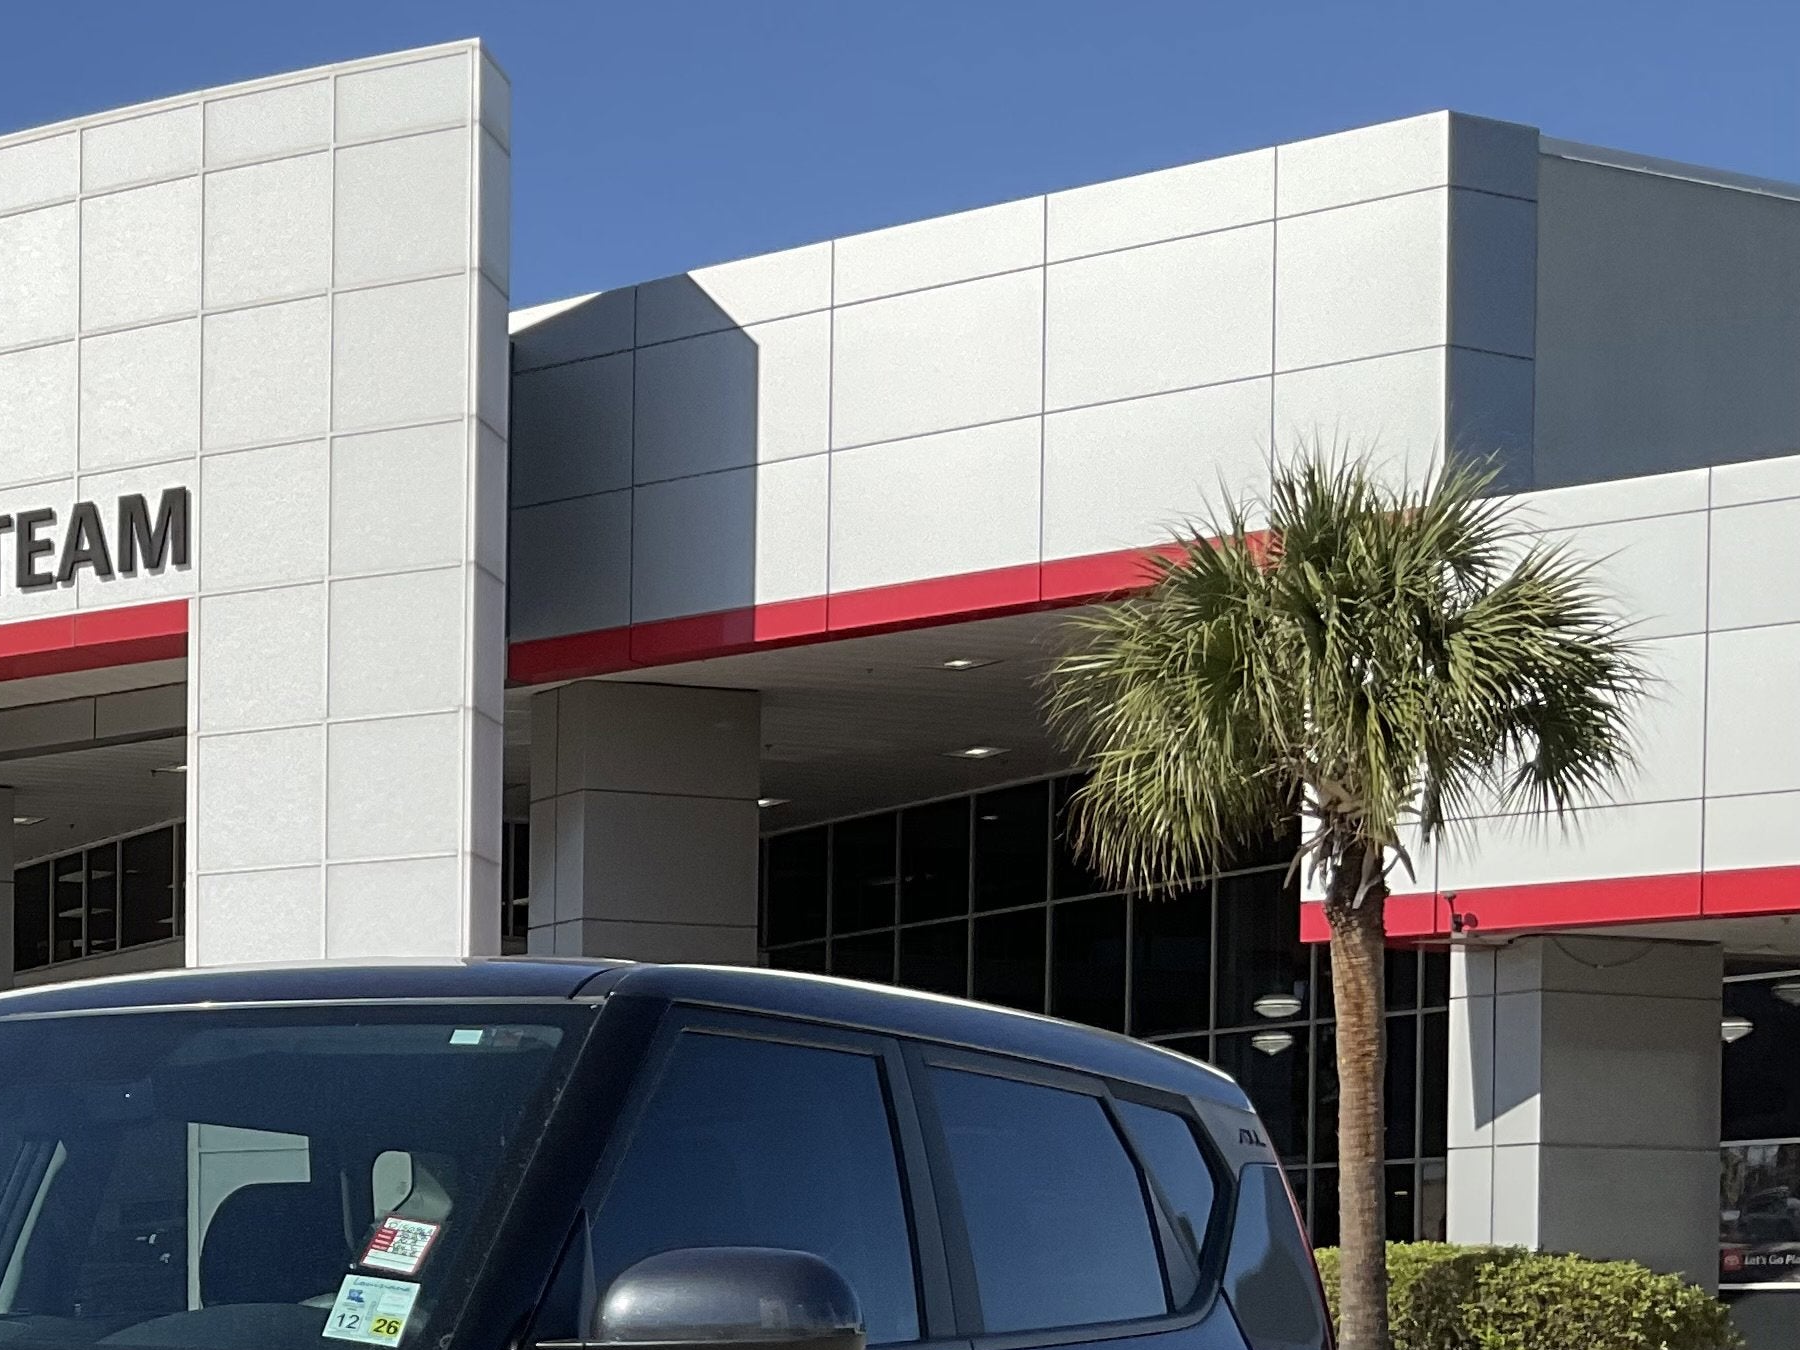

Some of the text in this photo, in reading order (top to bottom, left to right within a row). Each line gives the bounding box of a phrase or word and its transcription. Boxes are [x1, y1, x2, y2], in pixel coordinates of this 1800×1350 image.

[1768, 1254, 1784, 1265] Go
[336, 1313, 400, 1335] 12 26
